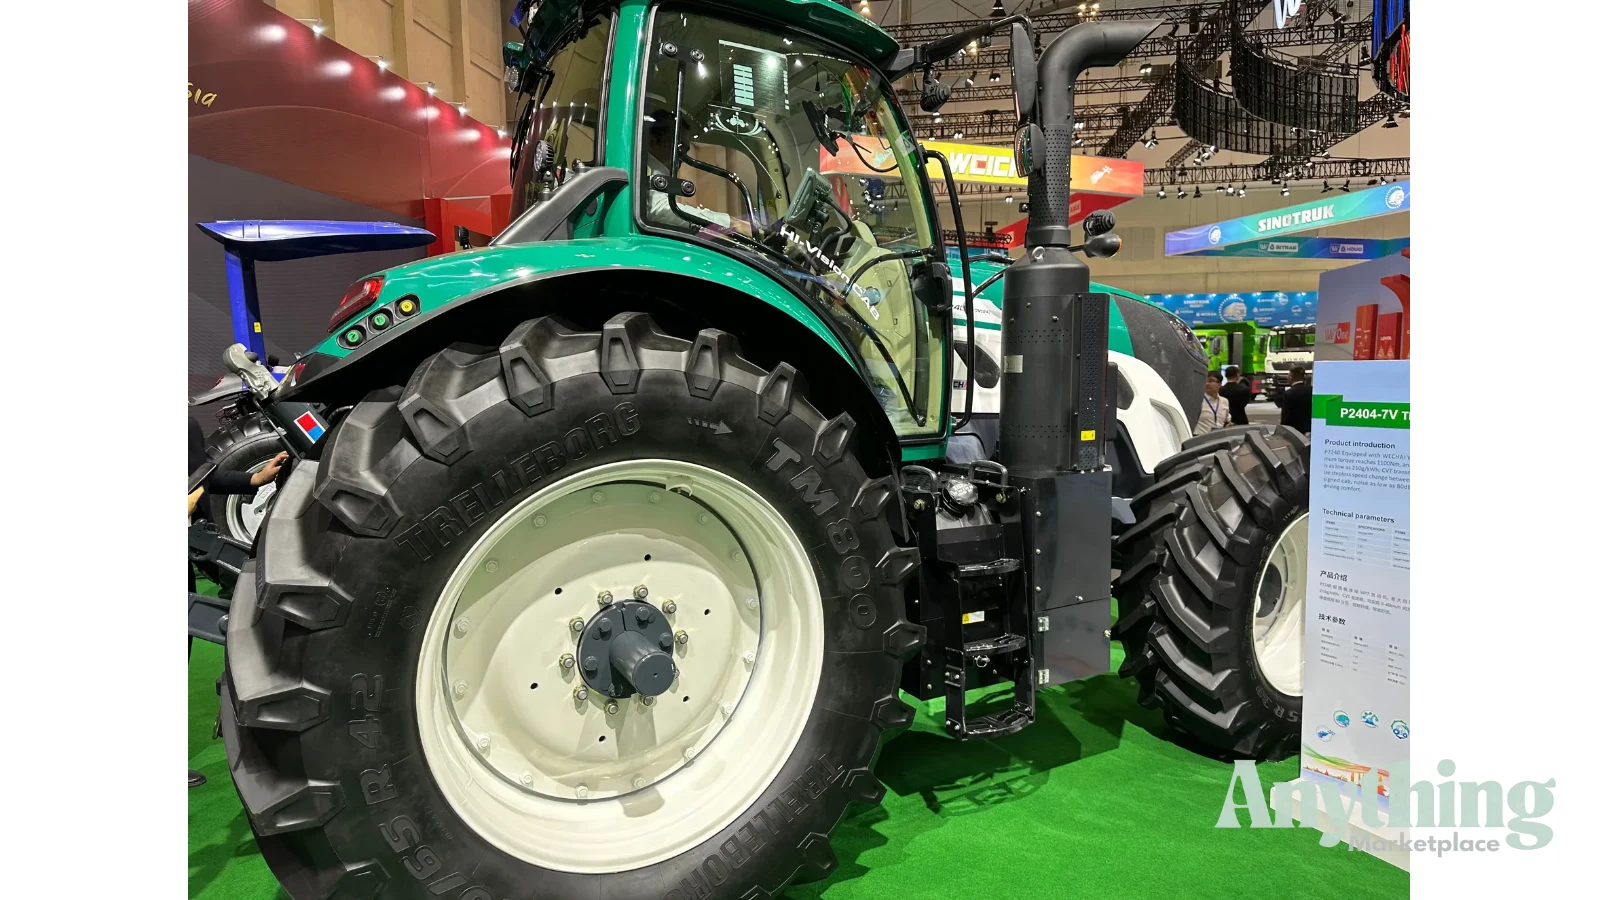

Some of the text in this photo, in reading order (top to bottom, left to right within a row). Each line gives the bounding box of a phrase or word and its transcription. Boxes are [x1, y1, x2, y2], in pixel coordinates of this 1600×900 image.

[1258, 204, 1335, 232] SINOTRUK
[1340, 408, 1398, 420] P2404-7V
[1324, 438, 1396, 449] Product introduction
[394, 401, 642, 562] TRELLEBORG
[1322, 508, 1395, 524] Technical parameters
[765, 437, 877, 630] TM800
[1319, 570, 1348, 582] 产品介绍
[1318, 613, 1346, 626] 技术参数
[347, 672, 383, 748] 42
[359, 763, 399, 805] R
